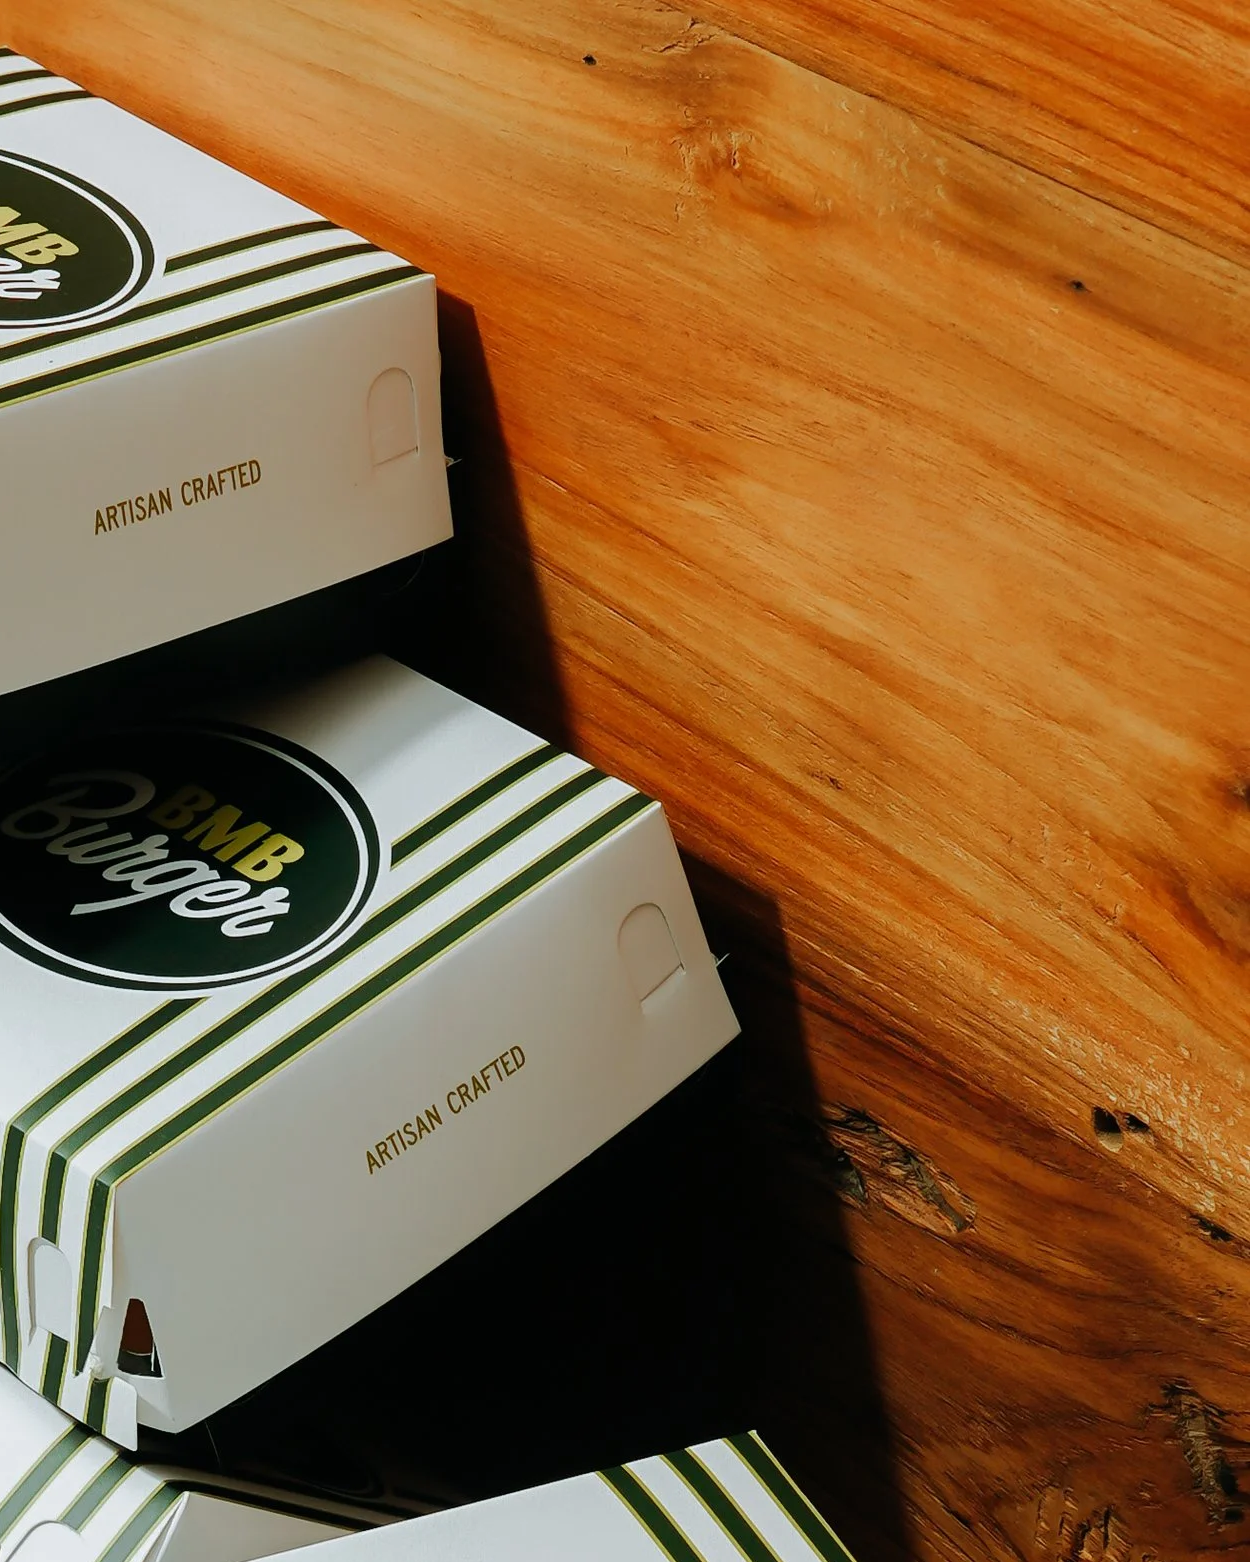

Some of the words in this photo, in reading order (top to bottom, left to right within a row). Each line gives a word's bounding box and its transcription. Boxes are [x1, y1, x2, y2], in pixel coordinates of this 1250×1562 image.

[92, 486, 173, 537] ARTISAN
[180, 459, 262, 505] CRAFTED
[1, 773, 292, 937] Burger
[151, 784, 304, 884] BMB
[365, 1104, 443, 1175] ARTISAN
[446, 1044, 526, 1114] CRAFTED
